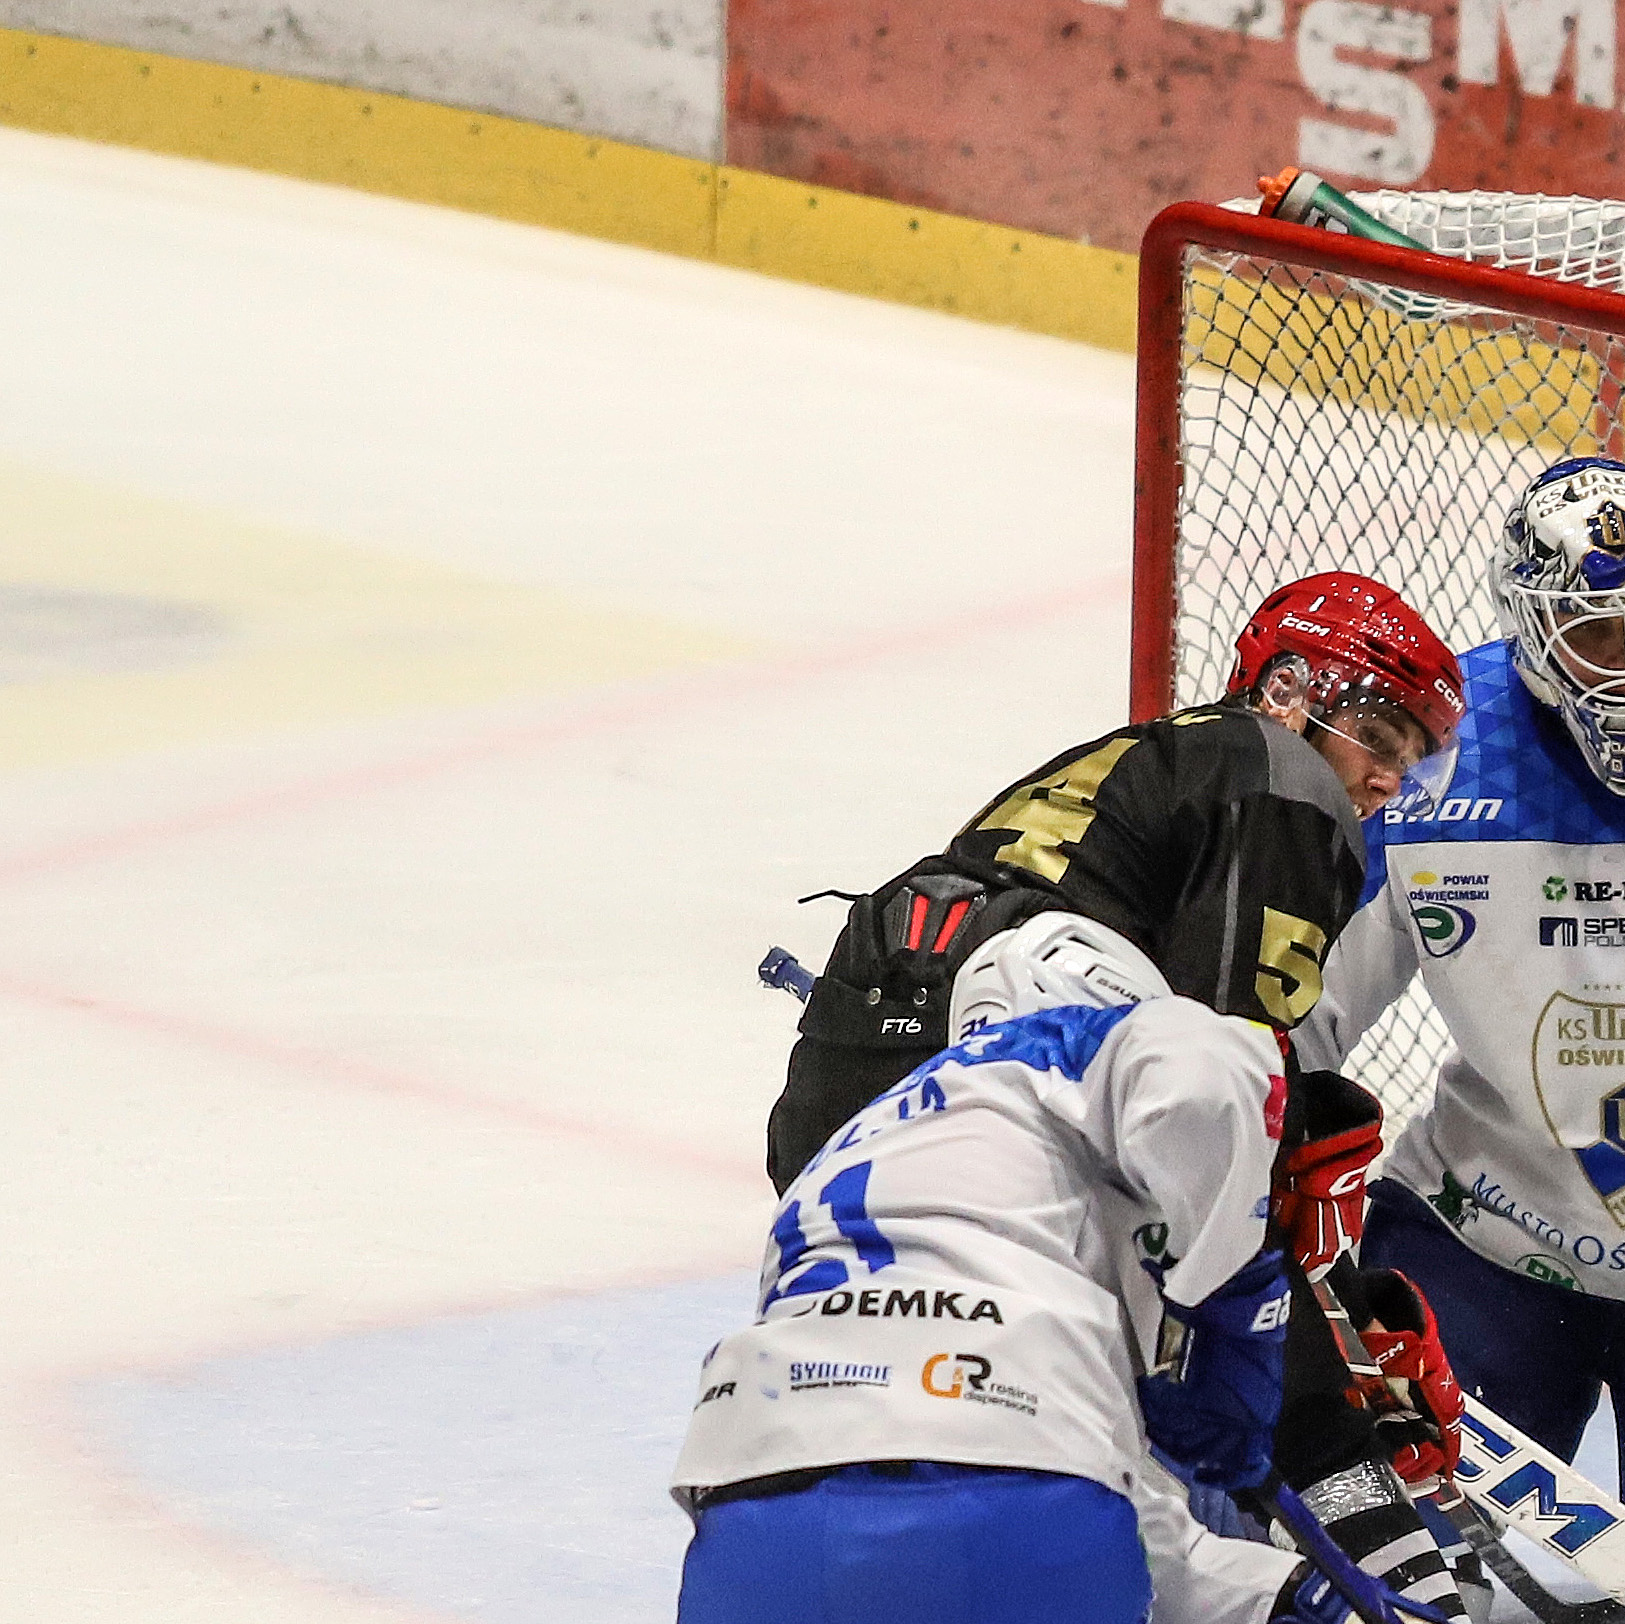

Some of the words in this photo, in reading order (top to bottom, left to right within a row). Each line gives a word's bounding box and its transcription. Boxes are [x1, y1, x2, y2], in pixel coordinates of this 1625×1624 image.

[1280, 616, 1332, 637] CCM
[1432, 677, 1466, 713] CCM
[1442, 874, 1490, 886] POWIAT
[1409, 888, 1490, 903] OŚWIĘCIMSKI
[1254, 905, 1328, 1028] 5
[880, 1018, 923, 1035] FT6
[1557, 1017, 1587, 1041] KS
[790, 1288, 1005, 1327] DEMKA
[1374, 1340, 1406, 1366] CM
